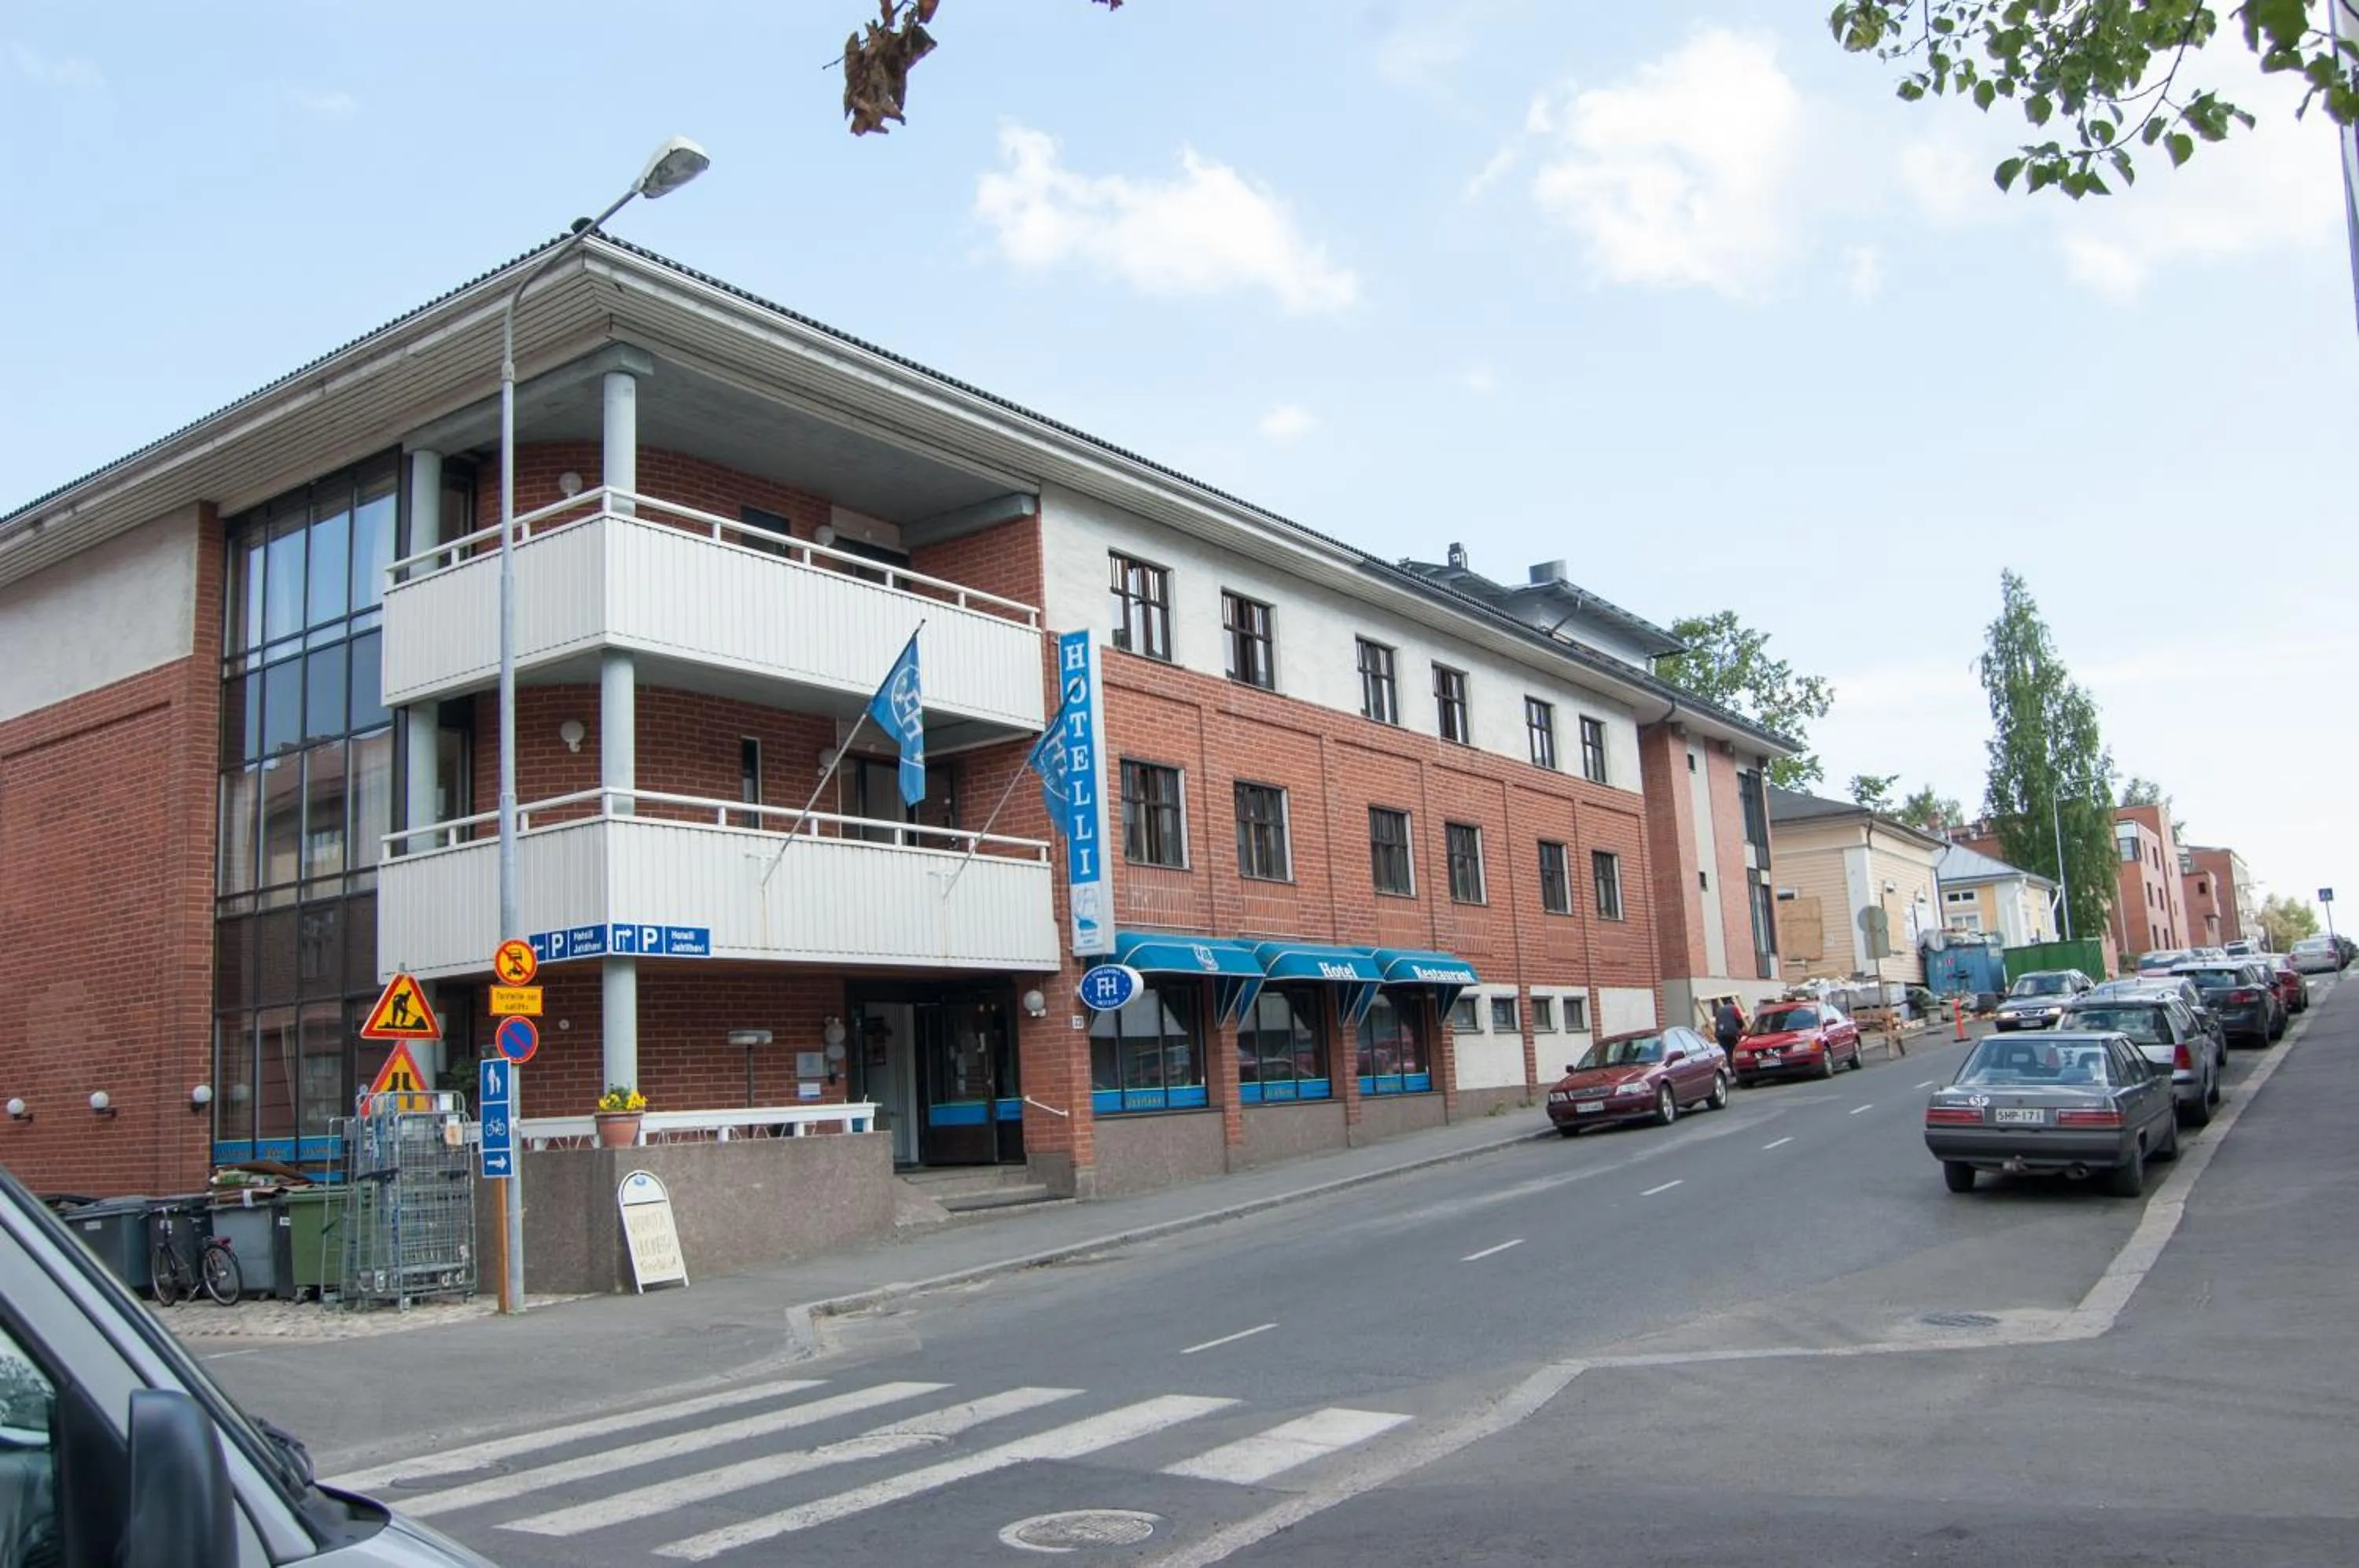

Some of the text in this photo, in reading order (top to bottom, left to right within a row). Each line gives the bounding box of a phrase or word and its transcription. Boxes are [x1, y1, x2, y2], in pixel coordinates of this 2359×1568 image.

[1065, 642, 1092, 875] HOTELLI
[551, 933, 564, 957] P
[642, 927, 657, 952] P
[1317, 962, 1359, 980] Hotel
[1411, 965, 1475, 982] Restaurant
[1998, 1109, 2041, 1121] SHP-171
